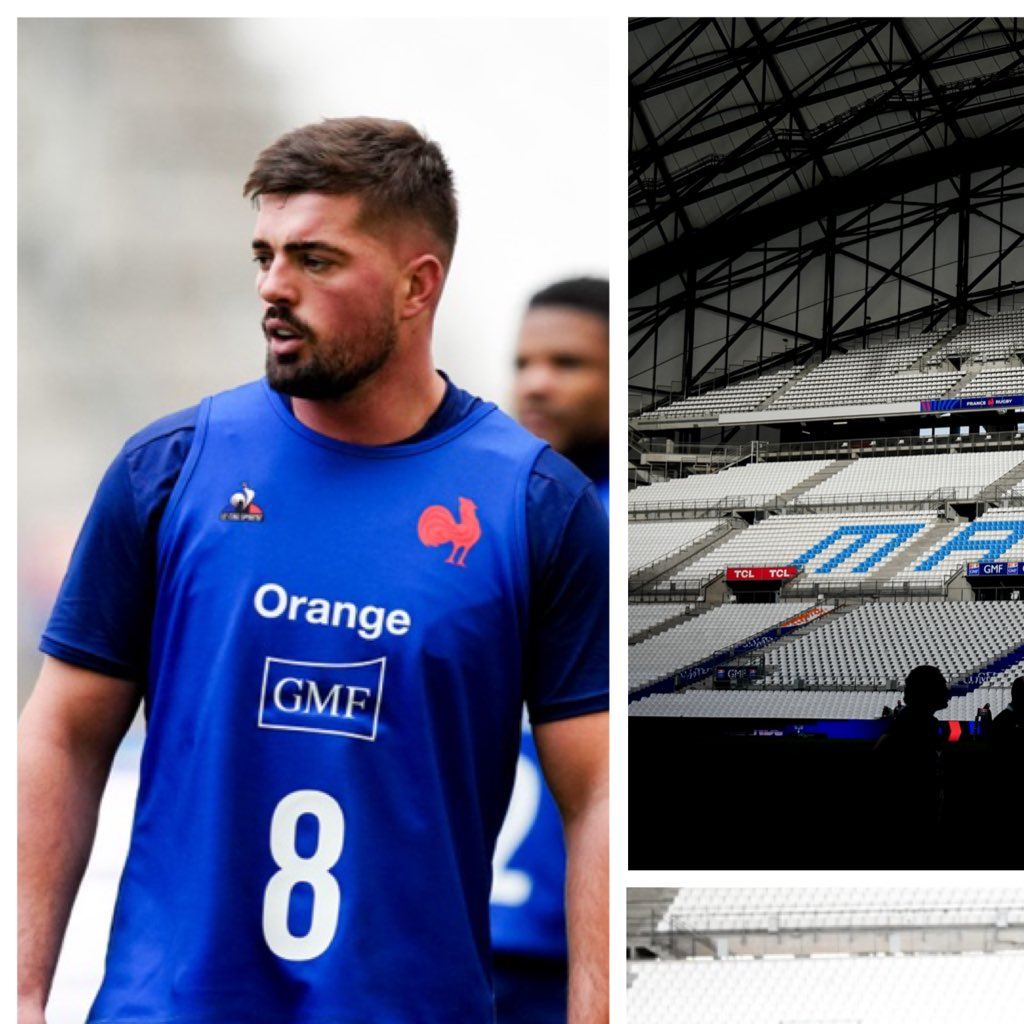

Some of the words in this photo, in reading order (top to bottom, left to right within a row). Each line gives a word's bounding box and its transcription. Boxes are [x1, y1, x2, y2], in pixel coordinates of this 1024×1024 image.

[966, 399, 987, 407] FRANCE
[734, 569, 755, 578] TCL
[769, 569, 790, 578] TCL
[983, 564, 1003, 574] GMF
[253, 583, 411, 640] Orange
[273, 677, 371, 719] GMF
[262, 789, 345, 962] 8
